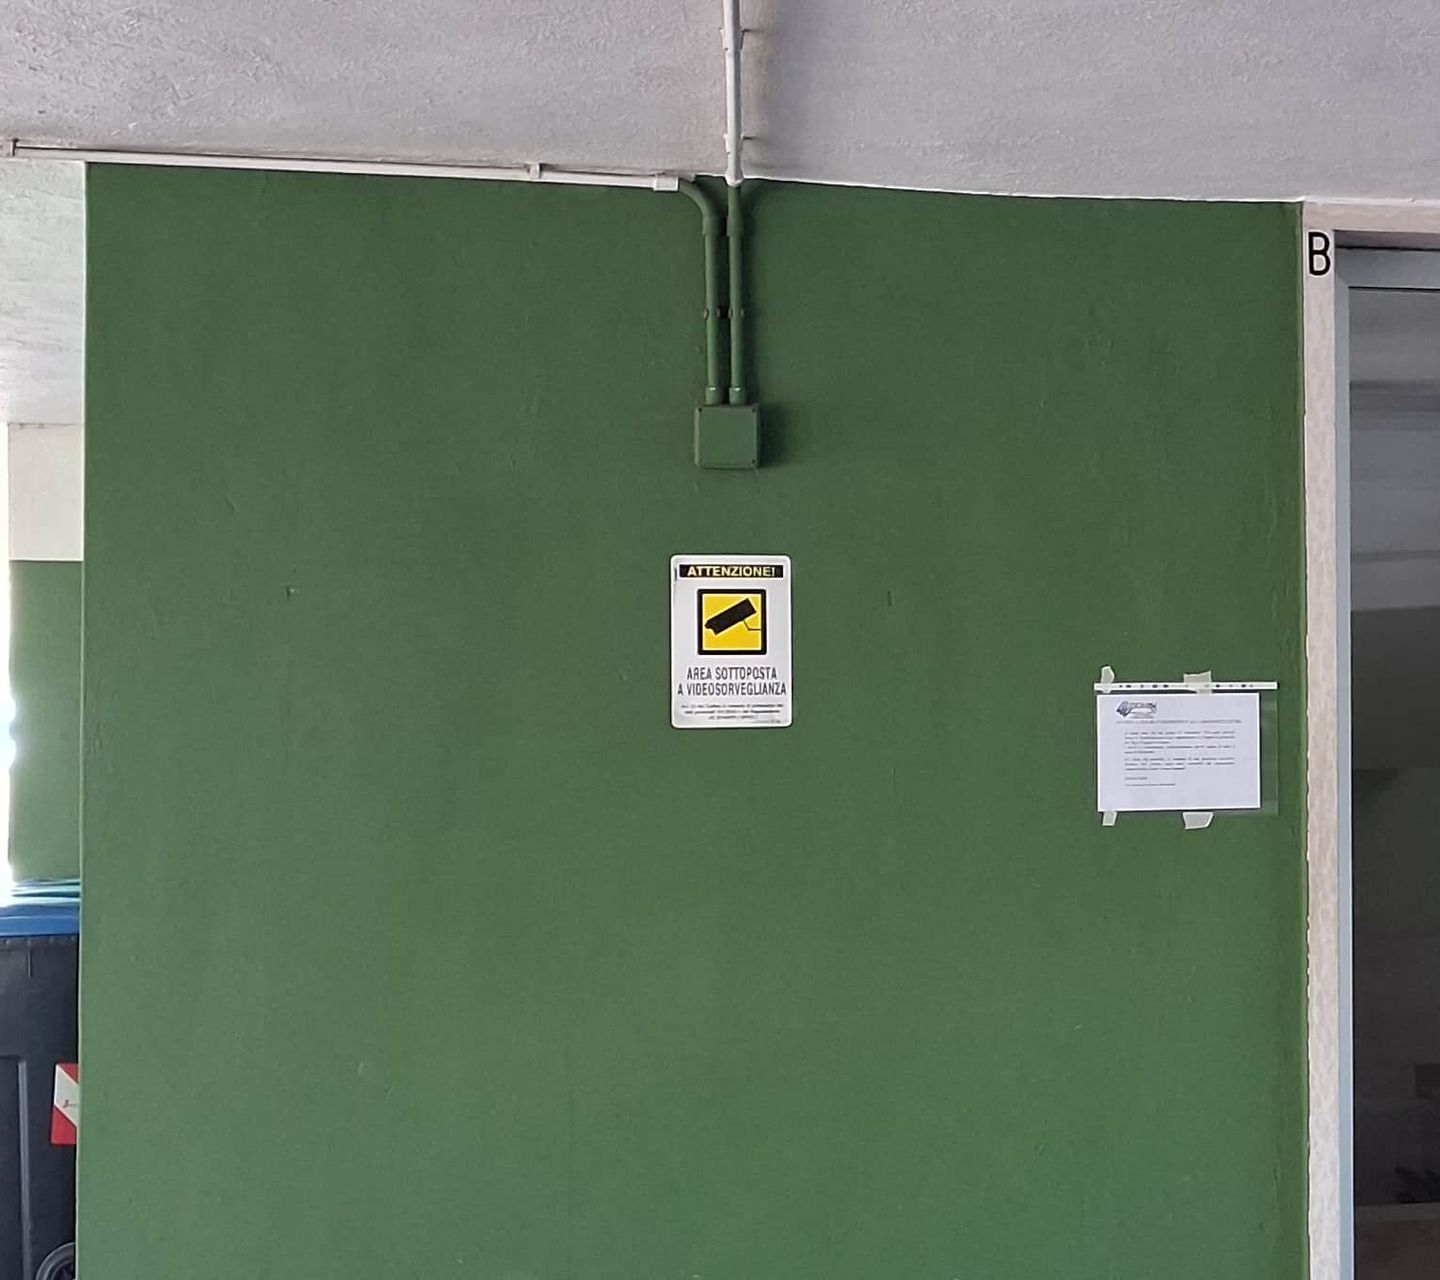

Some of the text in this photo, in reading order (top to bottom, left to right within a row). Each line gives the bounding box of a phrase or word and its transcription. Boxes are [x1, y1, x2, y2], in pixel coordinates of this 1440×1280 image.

[1308, 232, 1331, 276] B
[687, 565, 775, 577] ATTENZIONE!
[687, 666, 777, 680] AREA SOTTOPOSTA
[677, 682, 786, 696] A VIDEOSORVEGLIANZA
